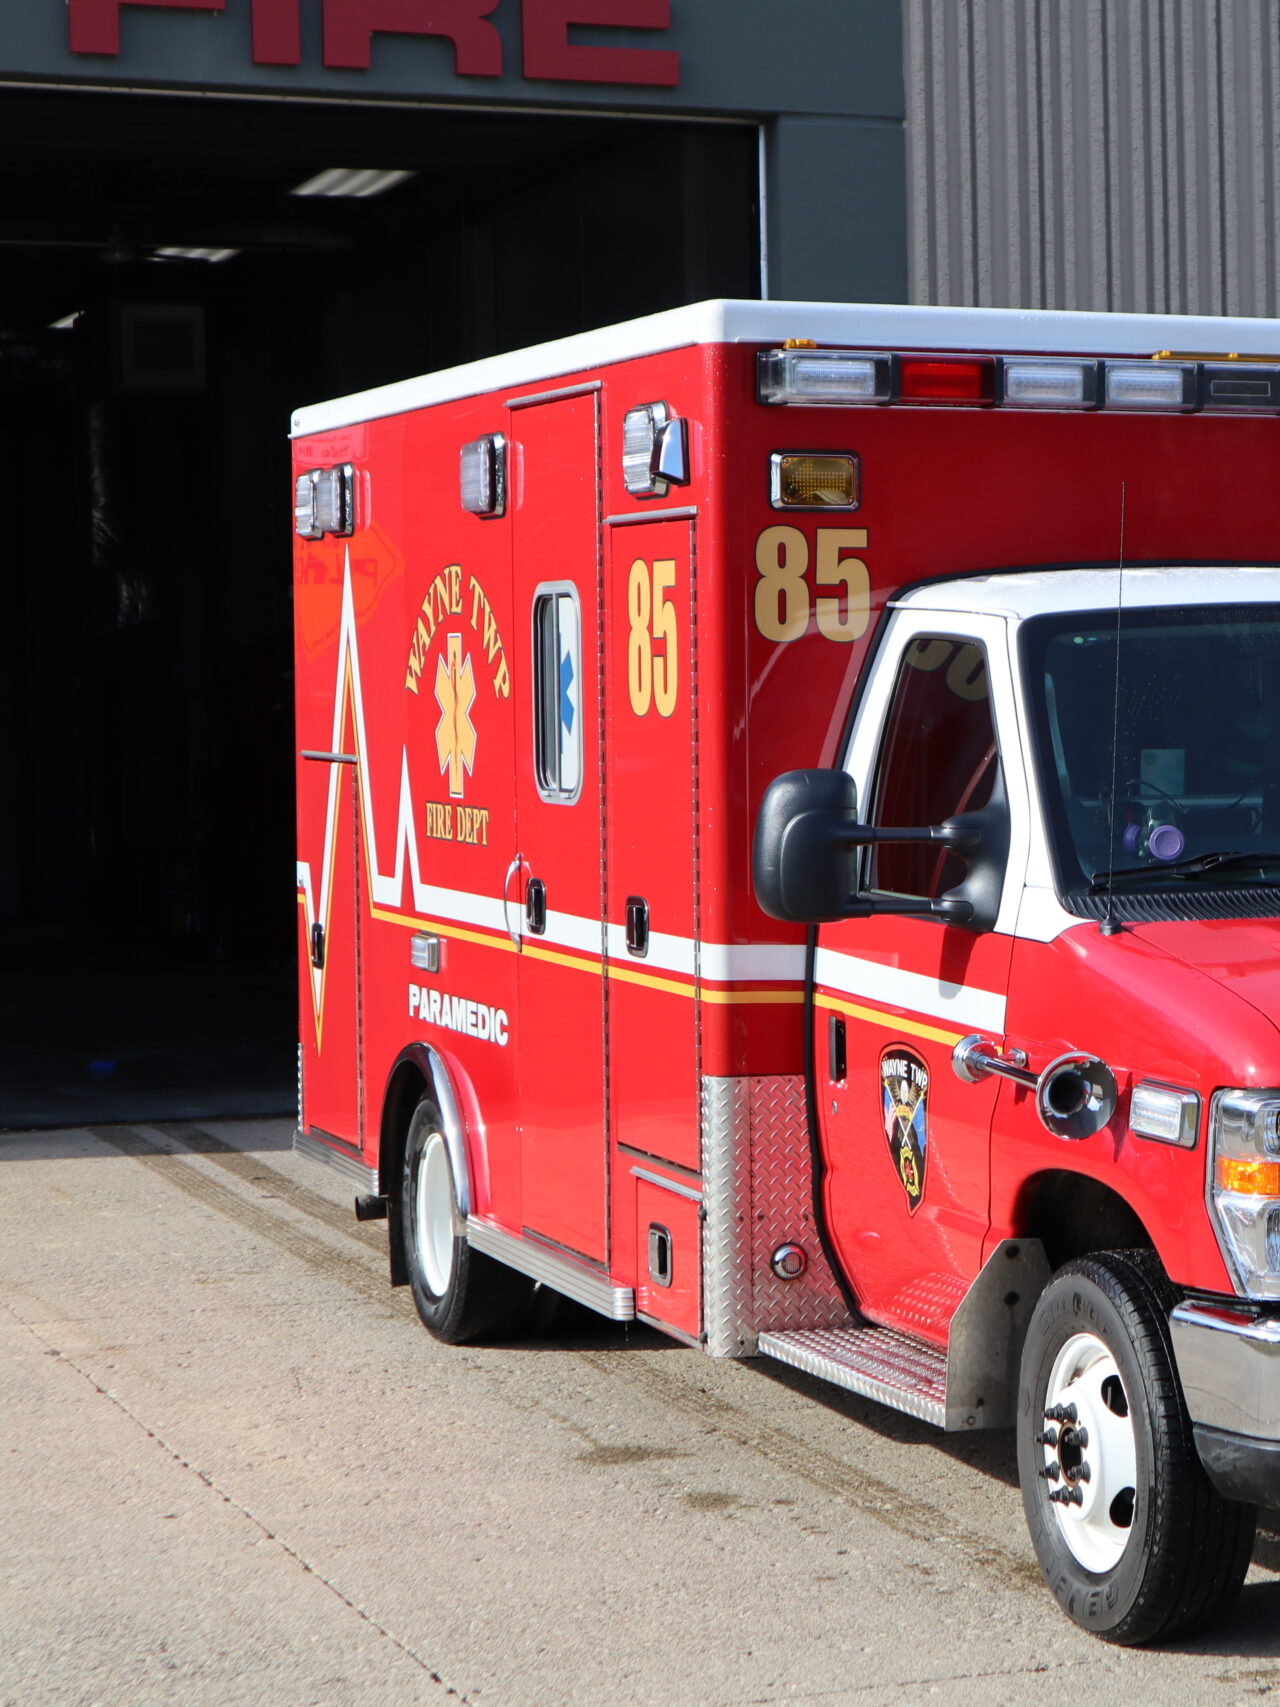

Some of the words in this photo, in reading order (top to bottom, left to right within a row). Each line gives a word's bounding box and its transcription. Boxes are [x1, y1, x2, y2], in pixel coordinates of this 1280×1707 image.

[753, 524, 871, 643] 85
[404, 563, 463, 696] WAYNE
[469, 574, 510, 699] TWP
[627, 558, 678, 718] 85
[425, 800, 453, 841] FIRE
[456, 804, 489, 847] DEPT
[408, 983, 509, 1047] PARAMEDIC
[881, 1058, 908, 1078] WAYNE
[910, 1063, 928, 1089] TWP
